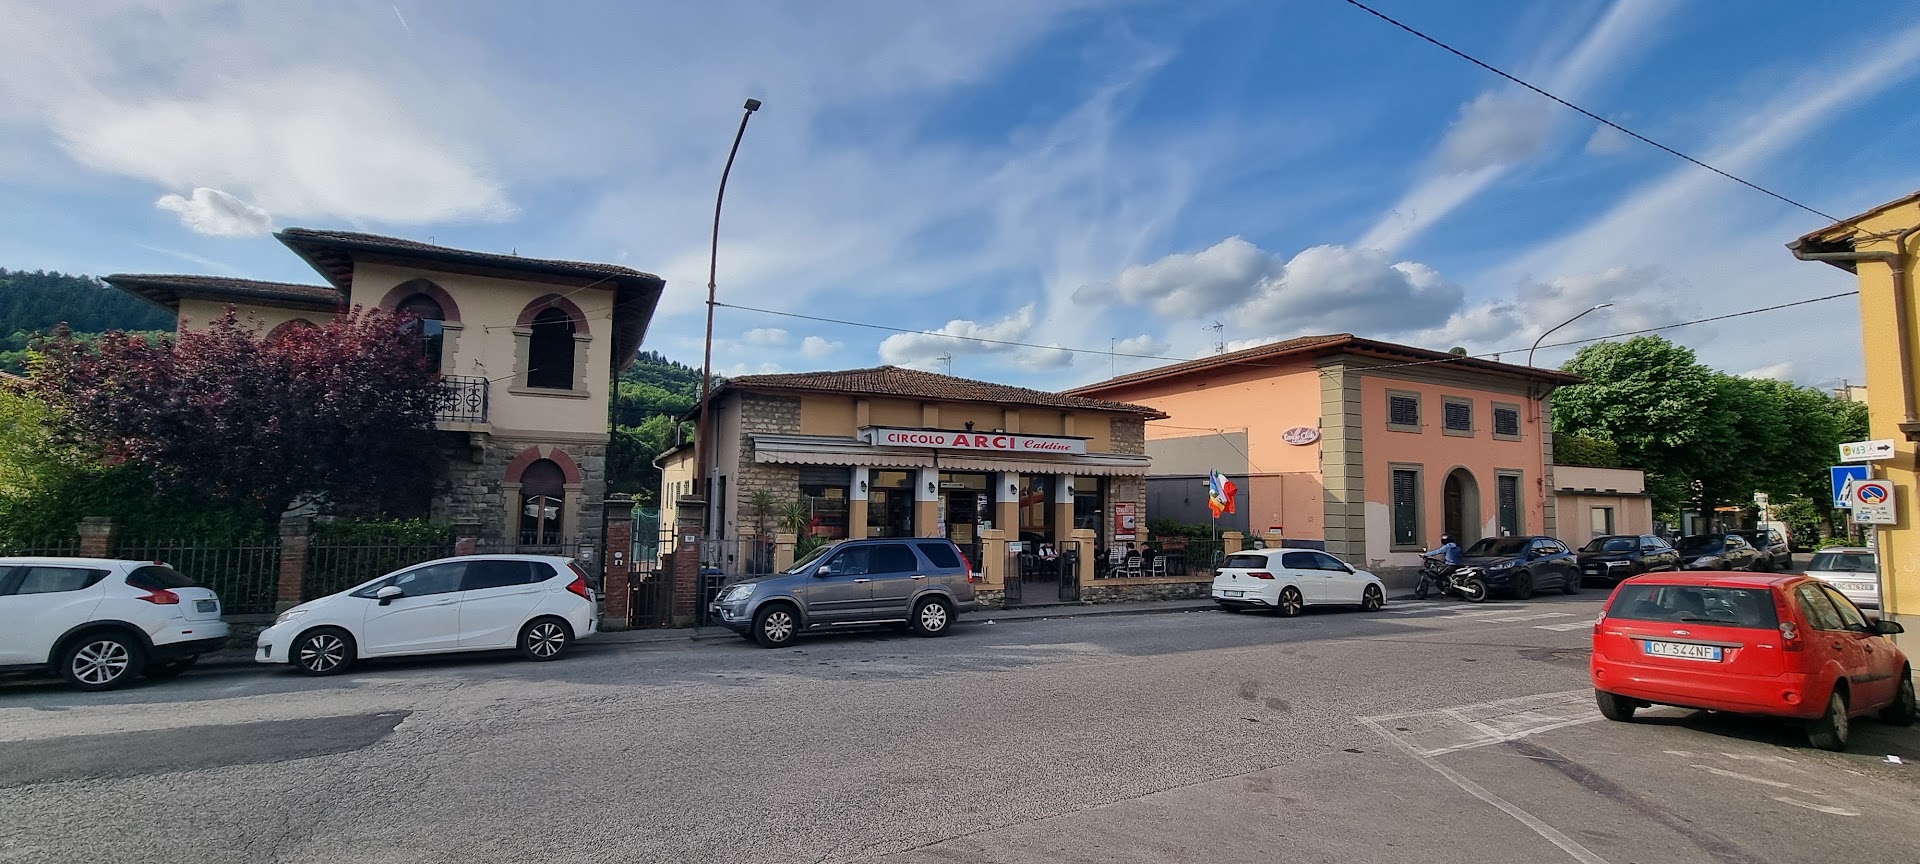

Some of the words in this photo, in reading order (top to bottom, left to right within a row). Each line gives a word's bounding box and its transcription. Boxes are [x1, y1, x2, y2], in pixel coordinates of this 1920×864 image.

[888, 433, 945, 445] CIRCOLO
[951, 434, 1015, 450] ARCI
[1022, 439, 1072, 451] Caldine
[1653, 643, 1667, 653] CY
[1672, 644, 1711, 657] 344NF
